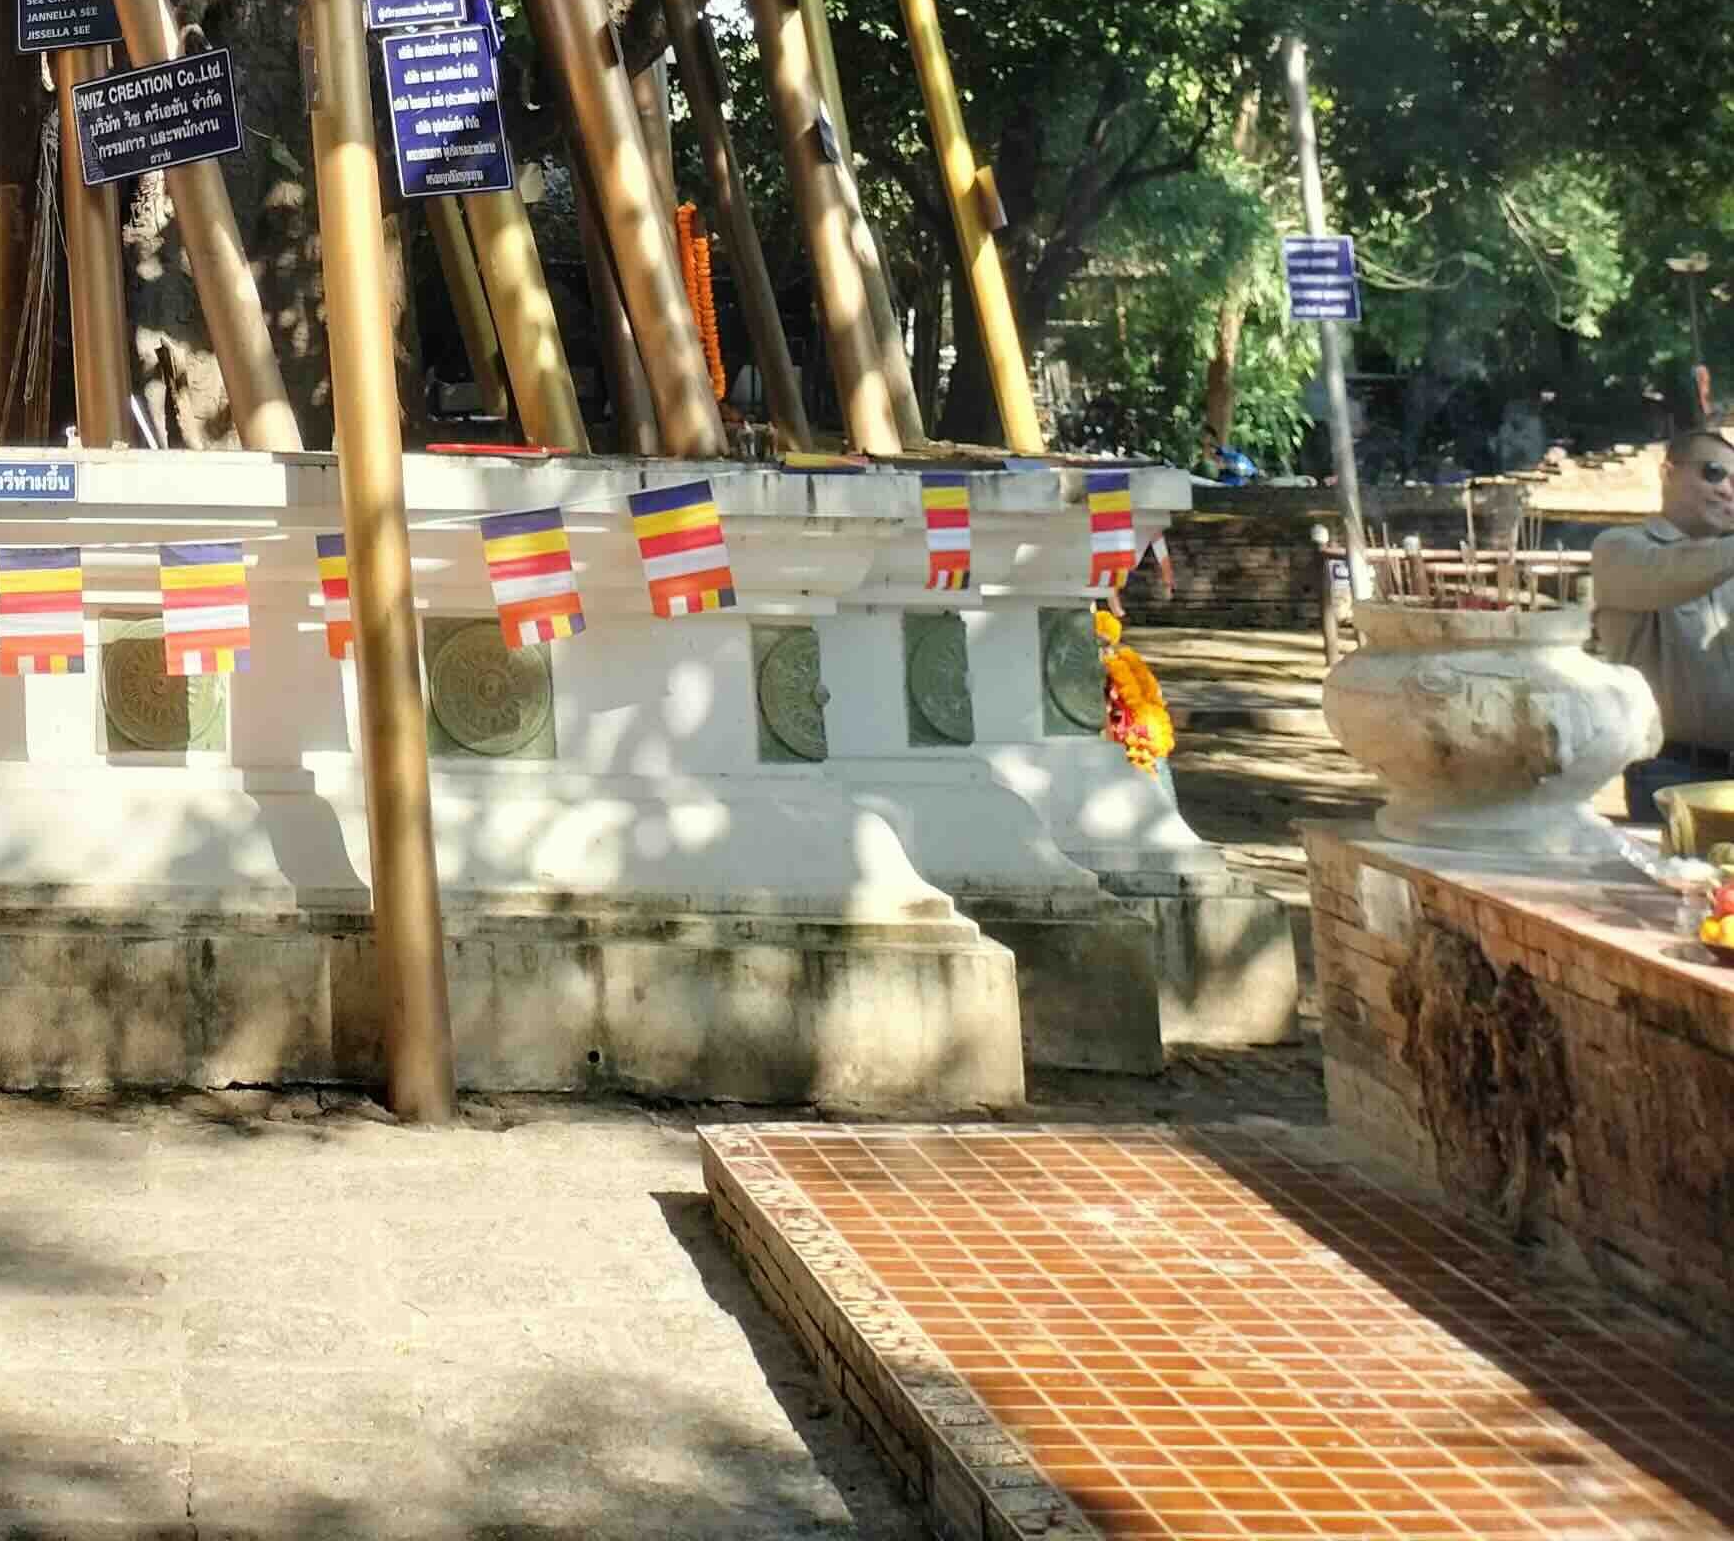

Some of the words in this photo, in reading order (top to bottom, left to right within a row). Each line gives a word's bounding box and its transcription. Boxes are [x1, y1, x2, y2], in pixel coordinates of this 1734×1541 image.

[26, 8, 76, 23] JANNELLA
[80, 5, 99, 17] SEE
[26, 26, 70, 40] JISSELLA
[73, 24, 91, 35] SEE
[108, 71, 173, 104] CREATION
[89, 111, 121, 137] บริษัท
[191, 88, 223, 111] จำกัด
[98, 136, 146, 161] กรรมการ
[149, 117, 220, 147] และพนักงาน
